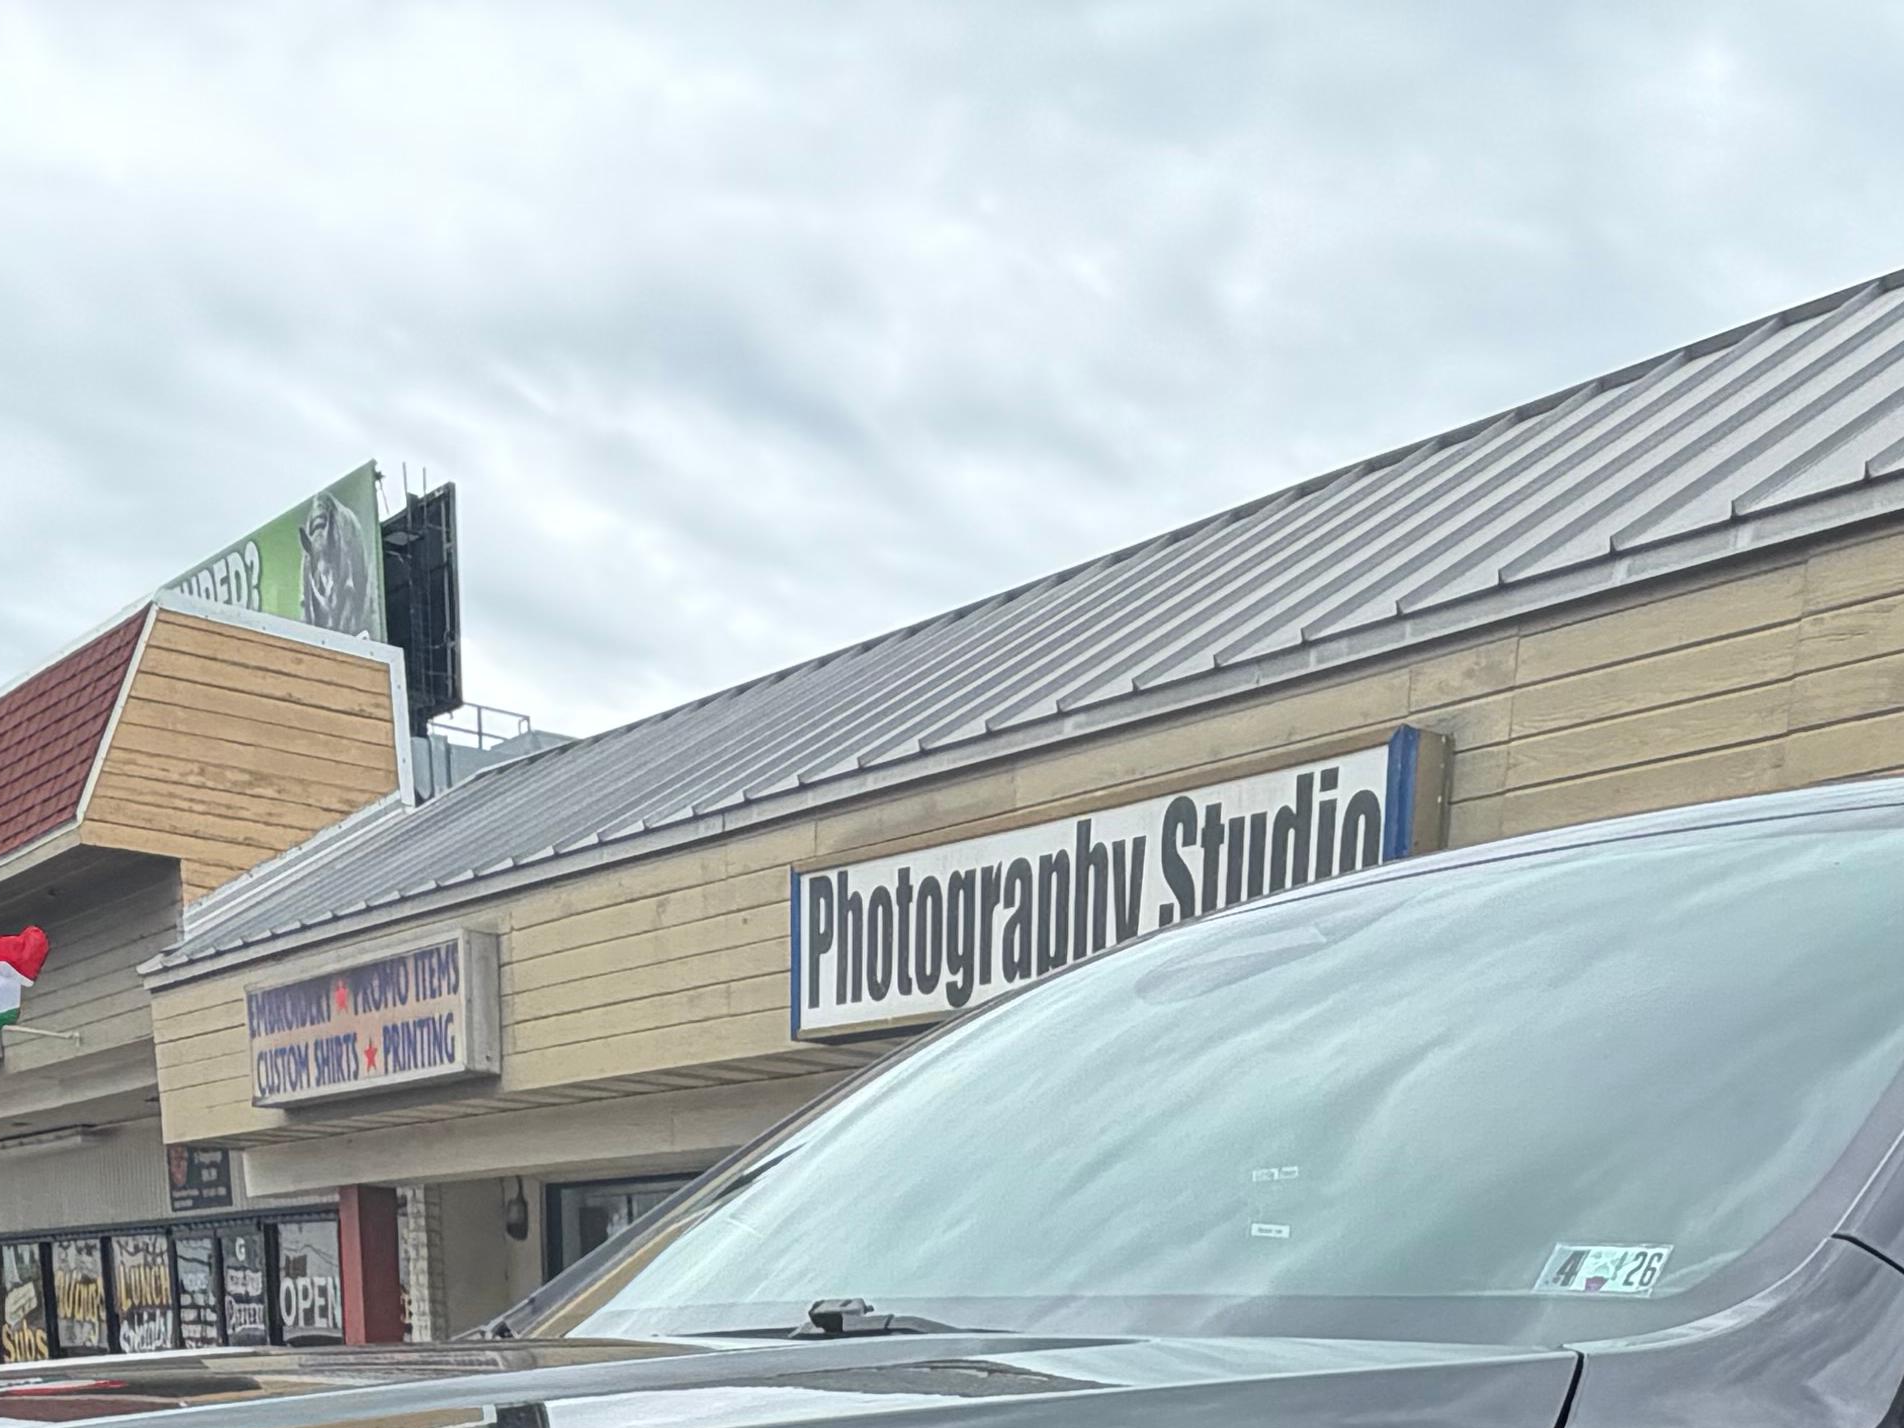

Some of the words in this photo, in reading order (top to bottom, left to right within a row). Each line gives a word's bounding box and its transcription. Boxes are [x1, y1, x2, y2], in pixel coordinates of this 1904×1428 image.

[807, 819, 1147, 1008] Photography
[1159, 766, 1382, 929] Studio
[248, 976, 332, 1039] EMBROIDERY
[352, 957, 410, 1015] PROMO
[414, 941, 459, 1002] ITEMS
[257, 1042, 311, 1097] CUSTOM
[313, 1032, 359, 1087] SHIRTS
[382, 1012, 455, 1075] PRINTING
[280, 1276, 341, 1328] OPEN
[1553, 1250, 1591, 1287] 4
[1622, 1251, 1663, 1287] 26
[2, 1319, 48, 1362] Subs
